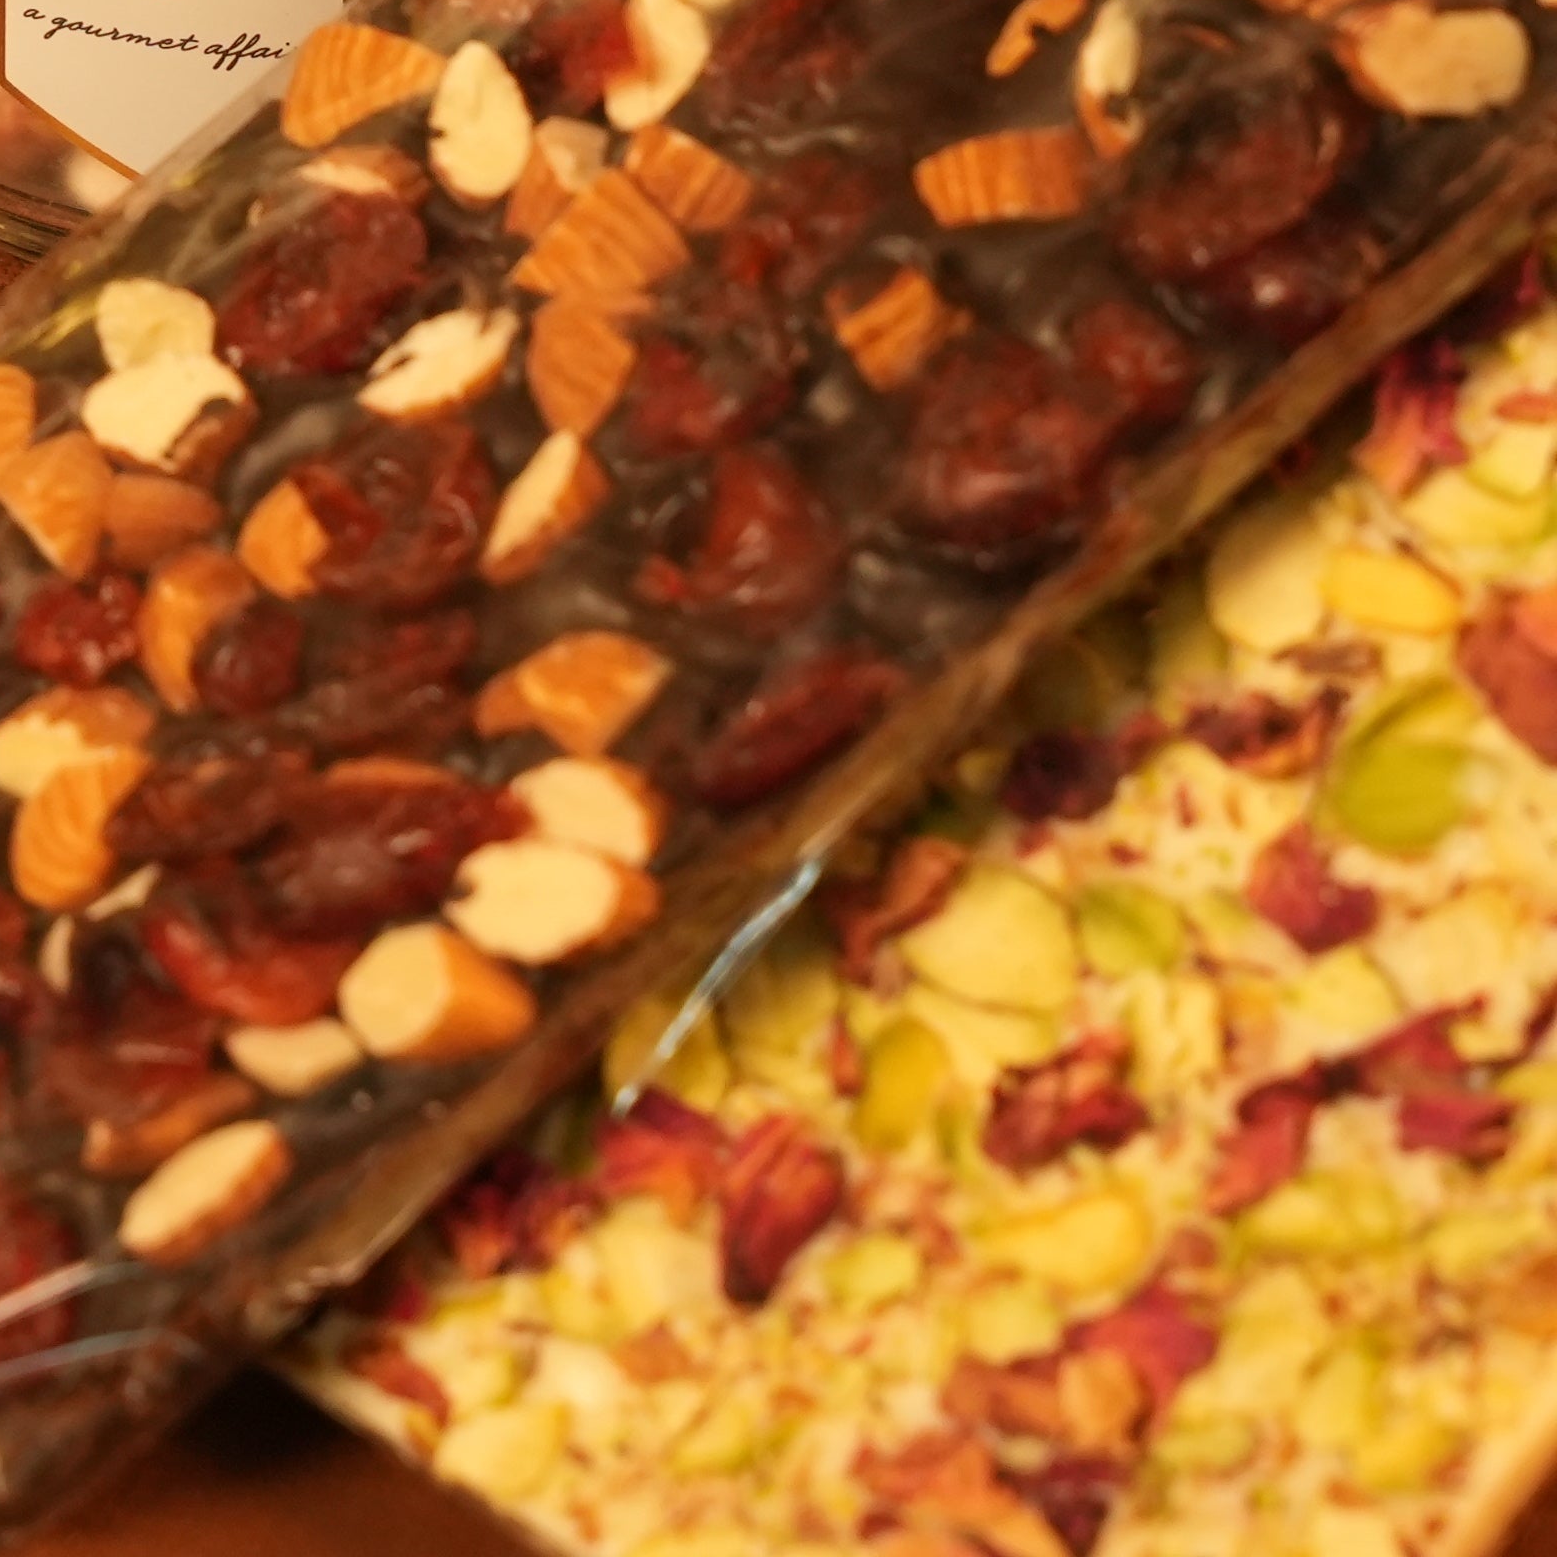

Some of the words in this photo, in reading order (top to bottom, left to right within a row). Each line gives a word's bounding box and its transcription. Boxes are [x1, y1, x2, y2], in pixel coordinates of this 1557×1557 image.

[22, 7, 46, 21] a
[43, 15, 199, 53] gourmet
[204, 32, 292, 72] affai
